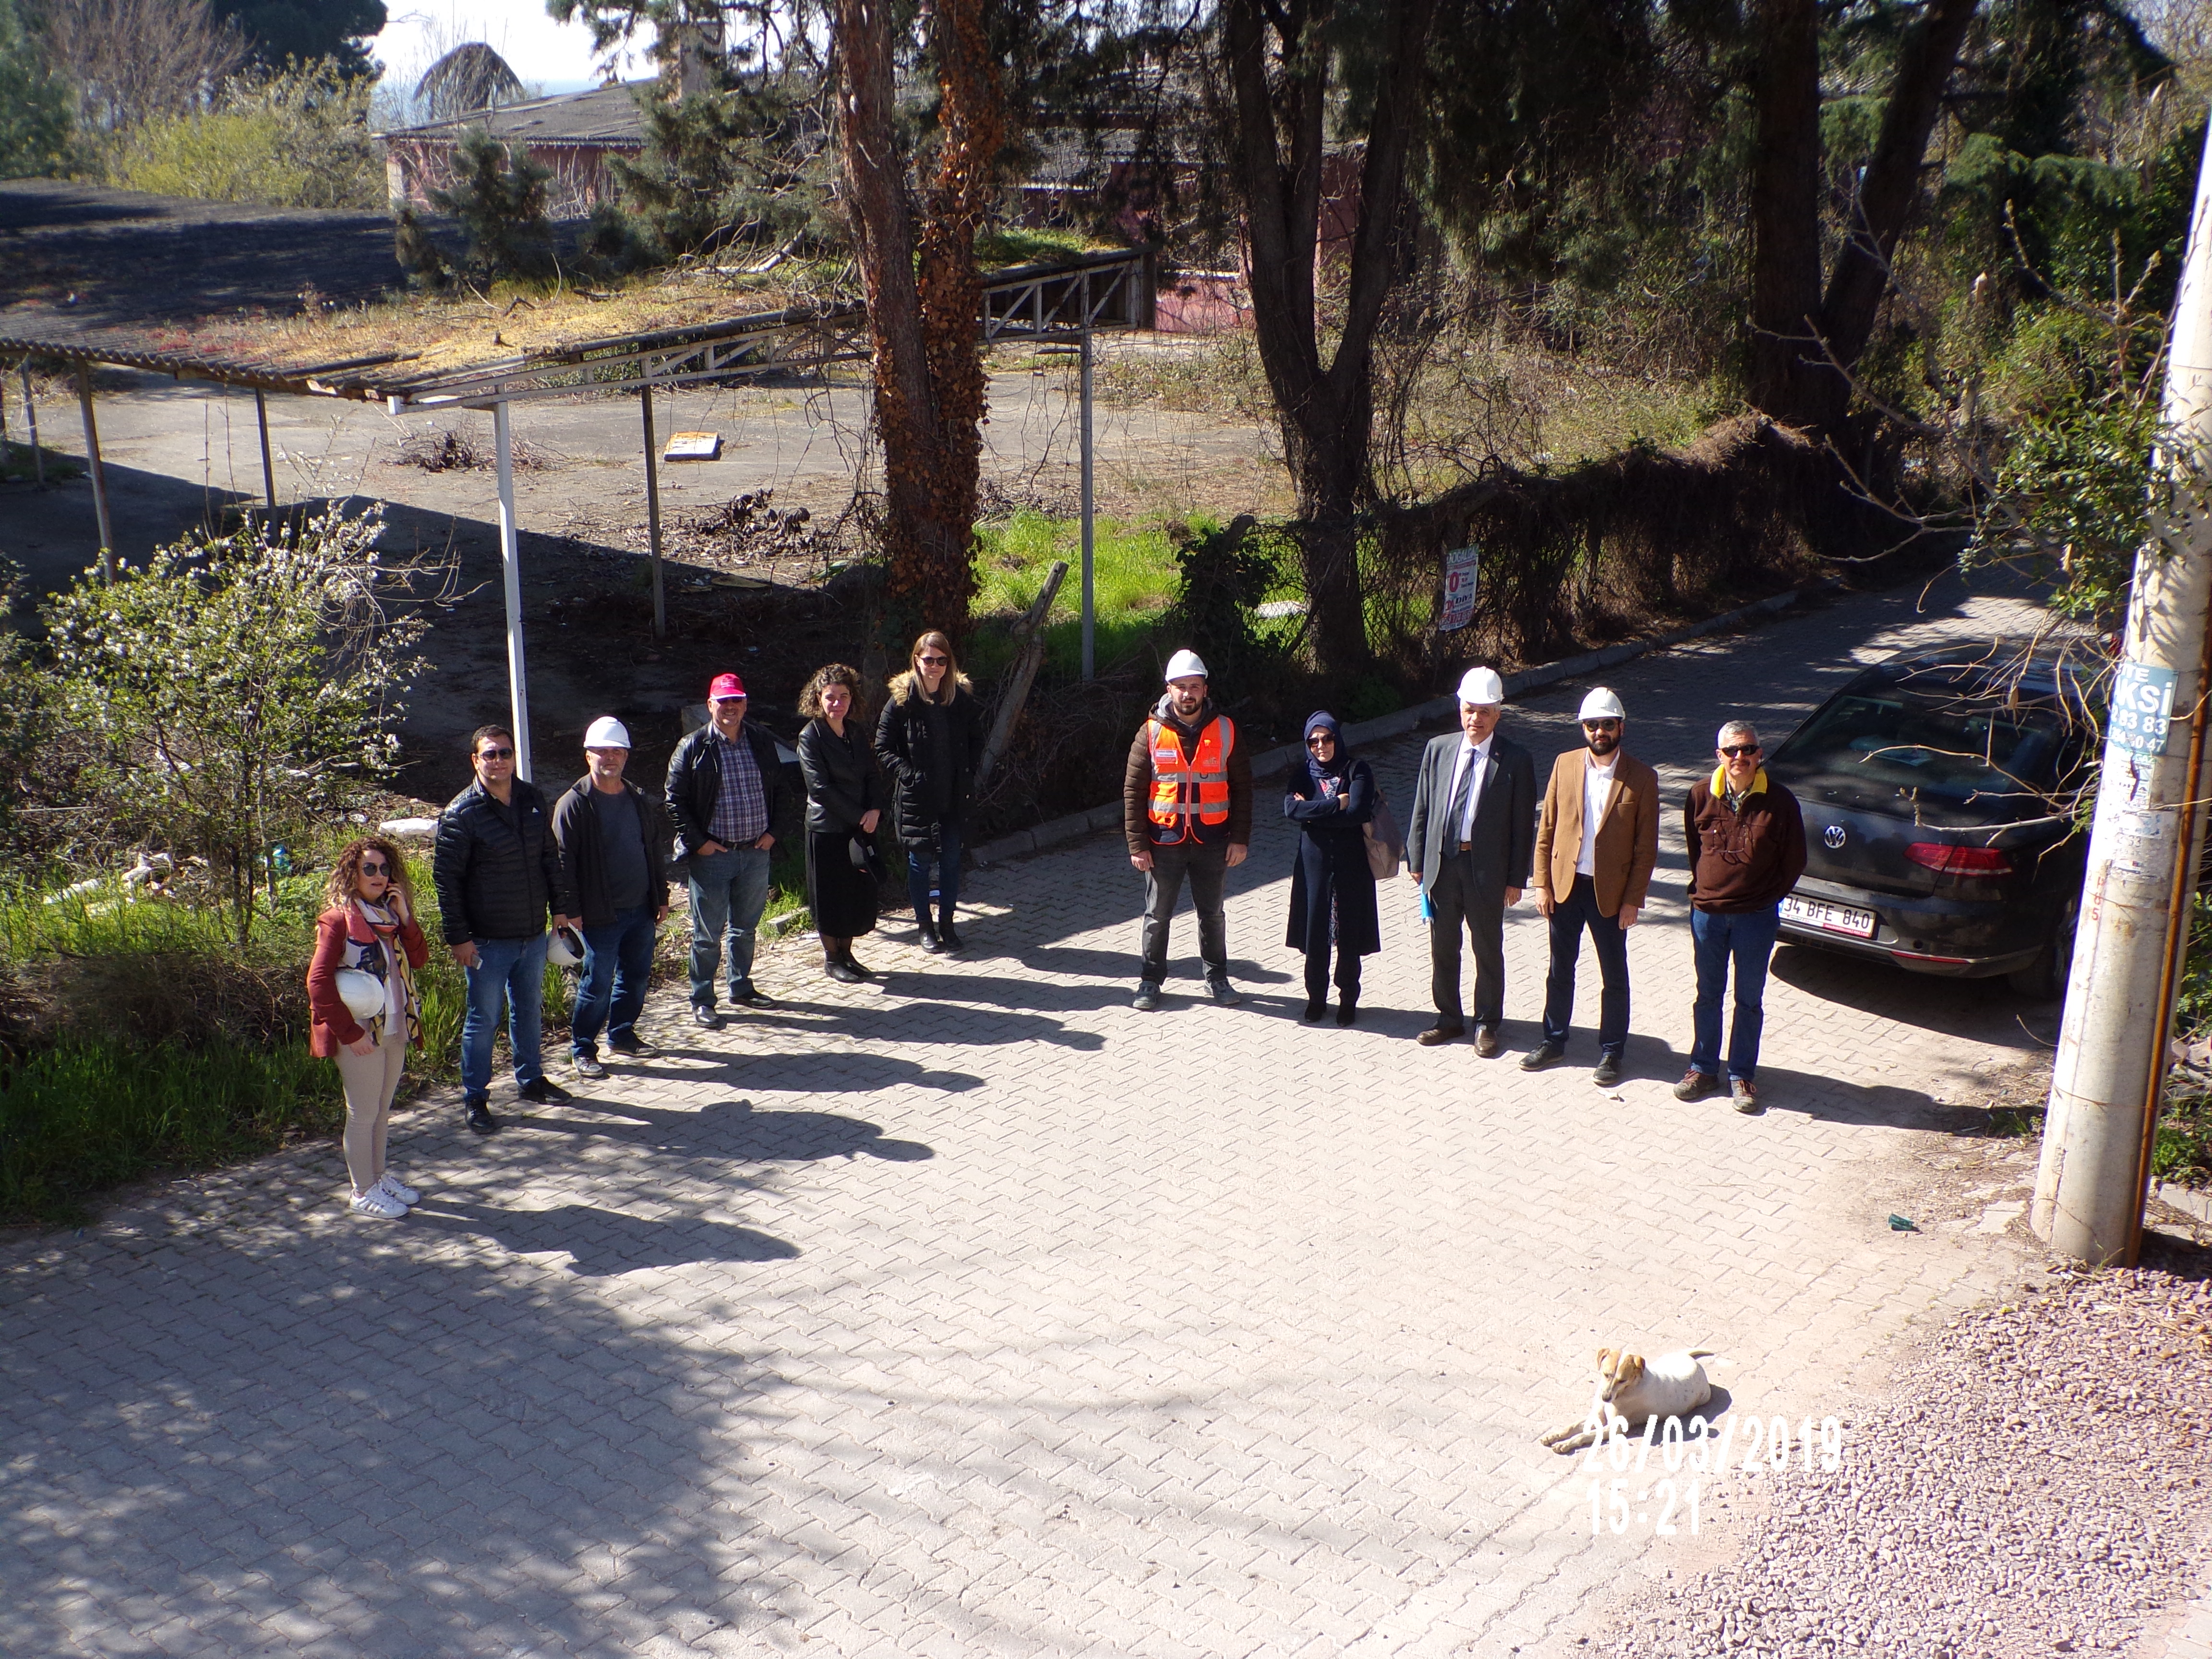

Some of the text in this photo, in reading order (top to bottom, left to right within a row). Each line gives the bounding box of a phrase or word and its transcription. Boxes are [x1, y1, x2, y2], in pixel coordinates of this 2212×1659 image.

[2142, 716, 2166, 734] 83
[1784, 896, 1801, 914] 34
[1807, 901, 1835, 922] BFE
[1842, 909, 1870, 929] 840
